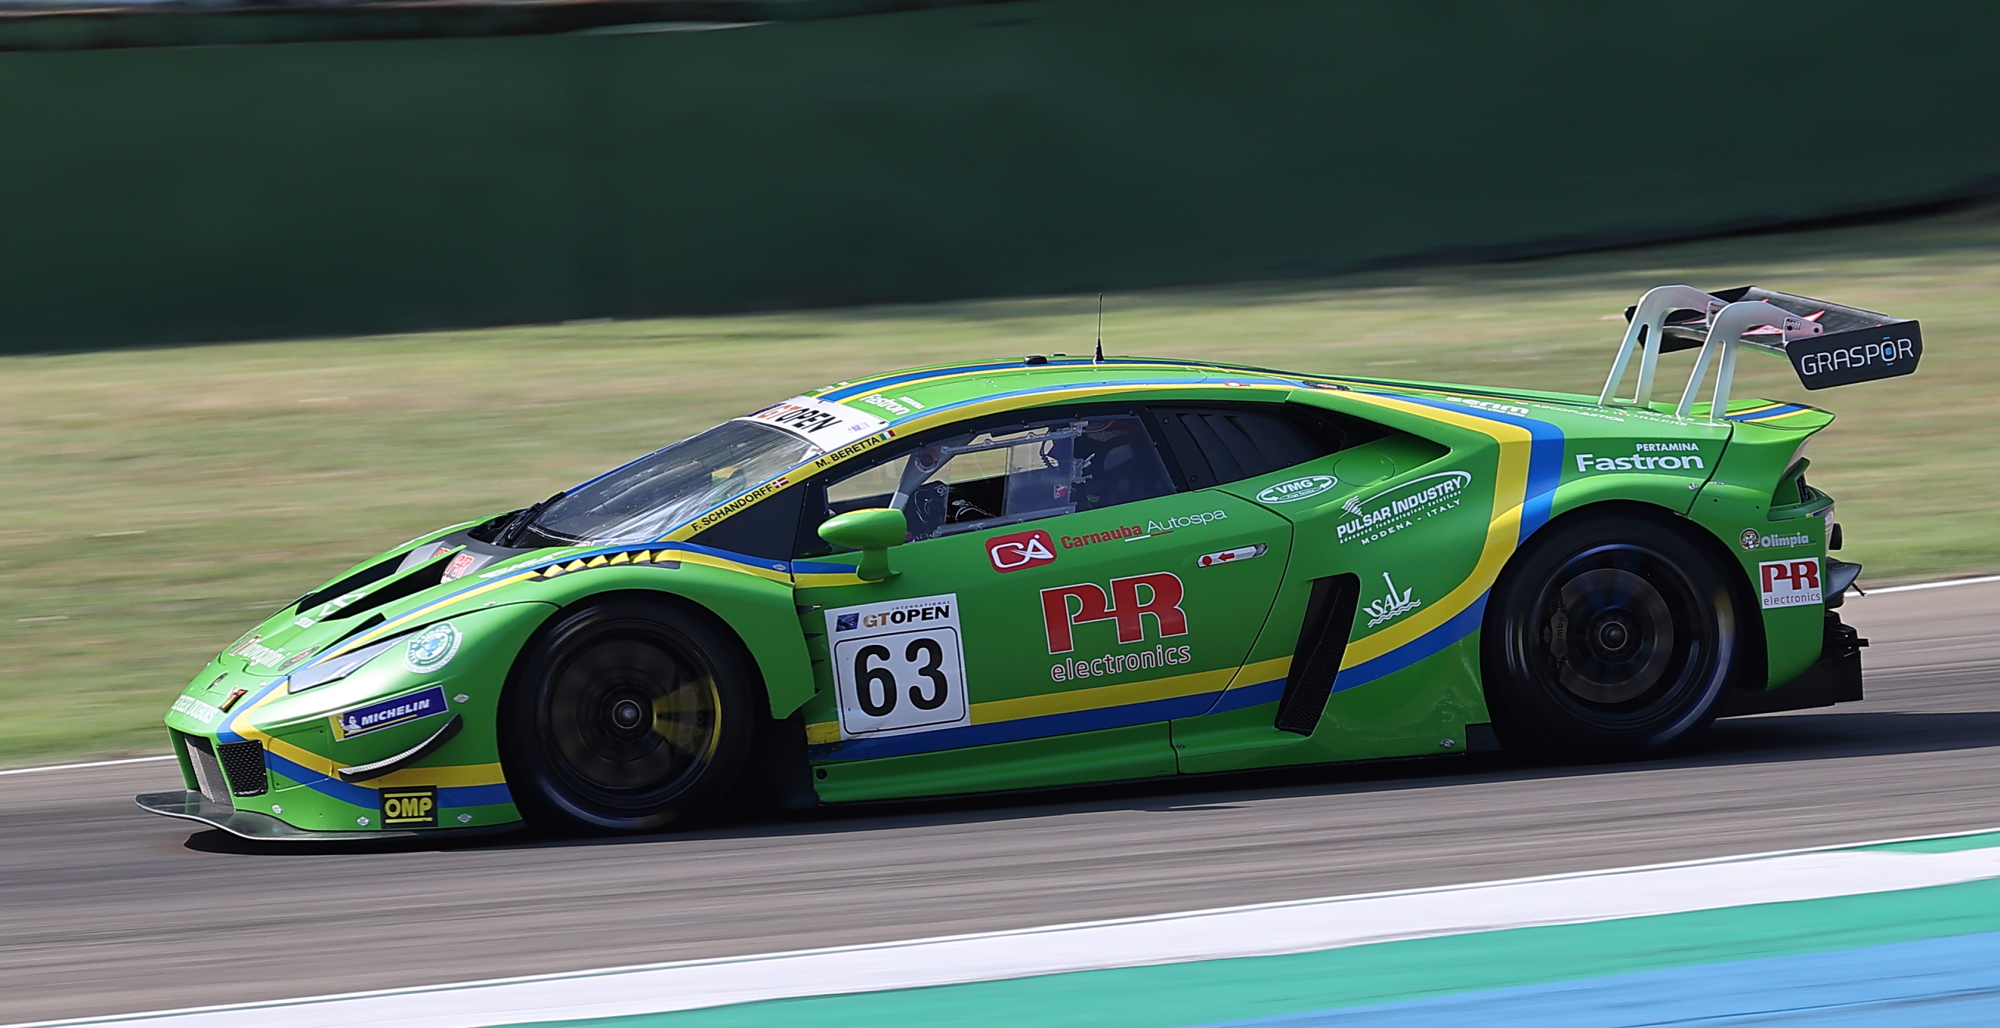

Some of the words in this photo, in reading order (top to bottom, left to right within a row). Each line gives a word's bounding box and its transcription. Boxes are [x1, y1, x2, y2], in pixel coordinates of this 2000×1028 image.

[859, 393, 911, 417] Fastron
[815, 459, 831, 469] M.
[832, 436, 881, 462] BERETTA
[1635, 443, 1700, 452] PERTAMINA
[1575, 453, 1704, 473] Fastron
[1275, 479, 1314, 494] VMG
[691, 523, 702, 532] F.
[702, 484, 775, 525] SCHANDORFF
[1336, 506, 1392, 538] PULSAR
[1391, 476, 1462, 515] INDUSTRY
[1060, 525, 1143, 549] Carnauba
[1146, 508, 1228, 534] Autospa
[1361, 520, 1413, 545] MODENA
[1426, 499, 1461, 517] ITALY
[1761, 532, 1810, 548] Olimpia
[1761, 561, 1820, 593] PR
[892, 600, 951, 611] INTERNATIONAL
[1039, 571, 1189, 655] PR
[1763, 592, 1821, 606] electronics
[854, 637, 949, 718] 63
[1051, 644, 1192, 682] electronics
[361, 699, 431, 726] MICHELIN
[384, 797, 433, 818] OMP
